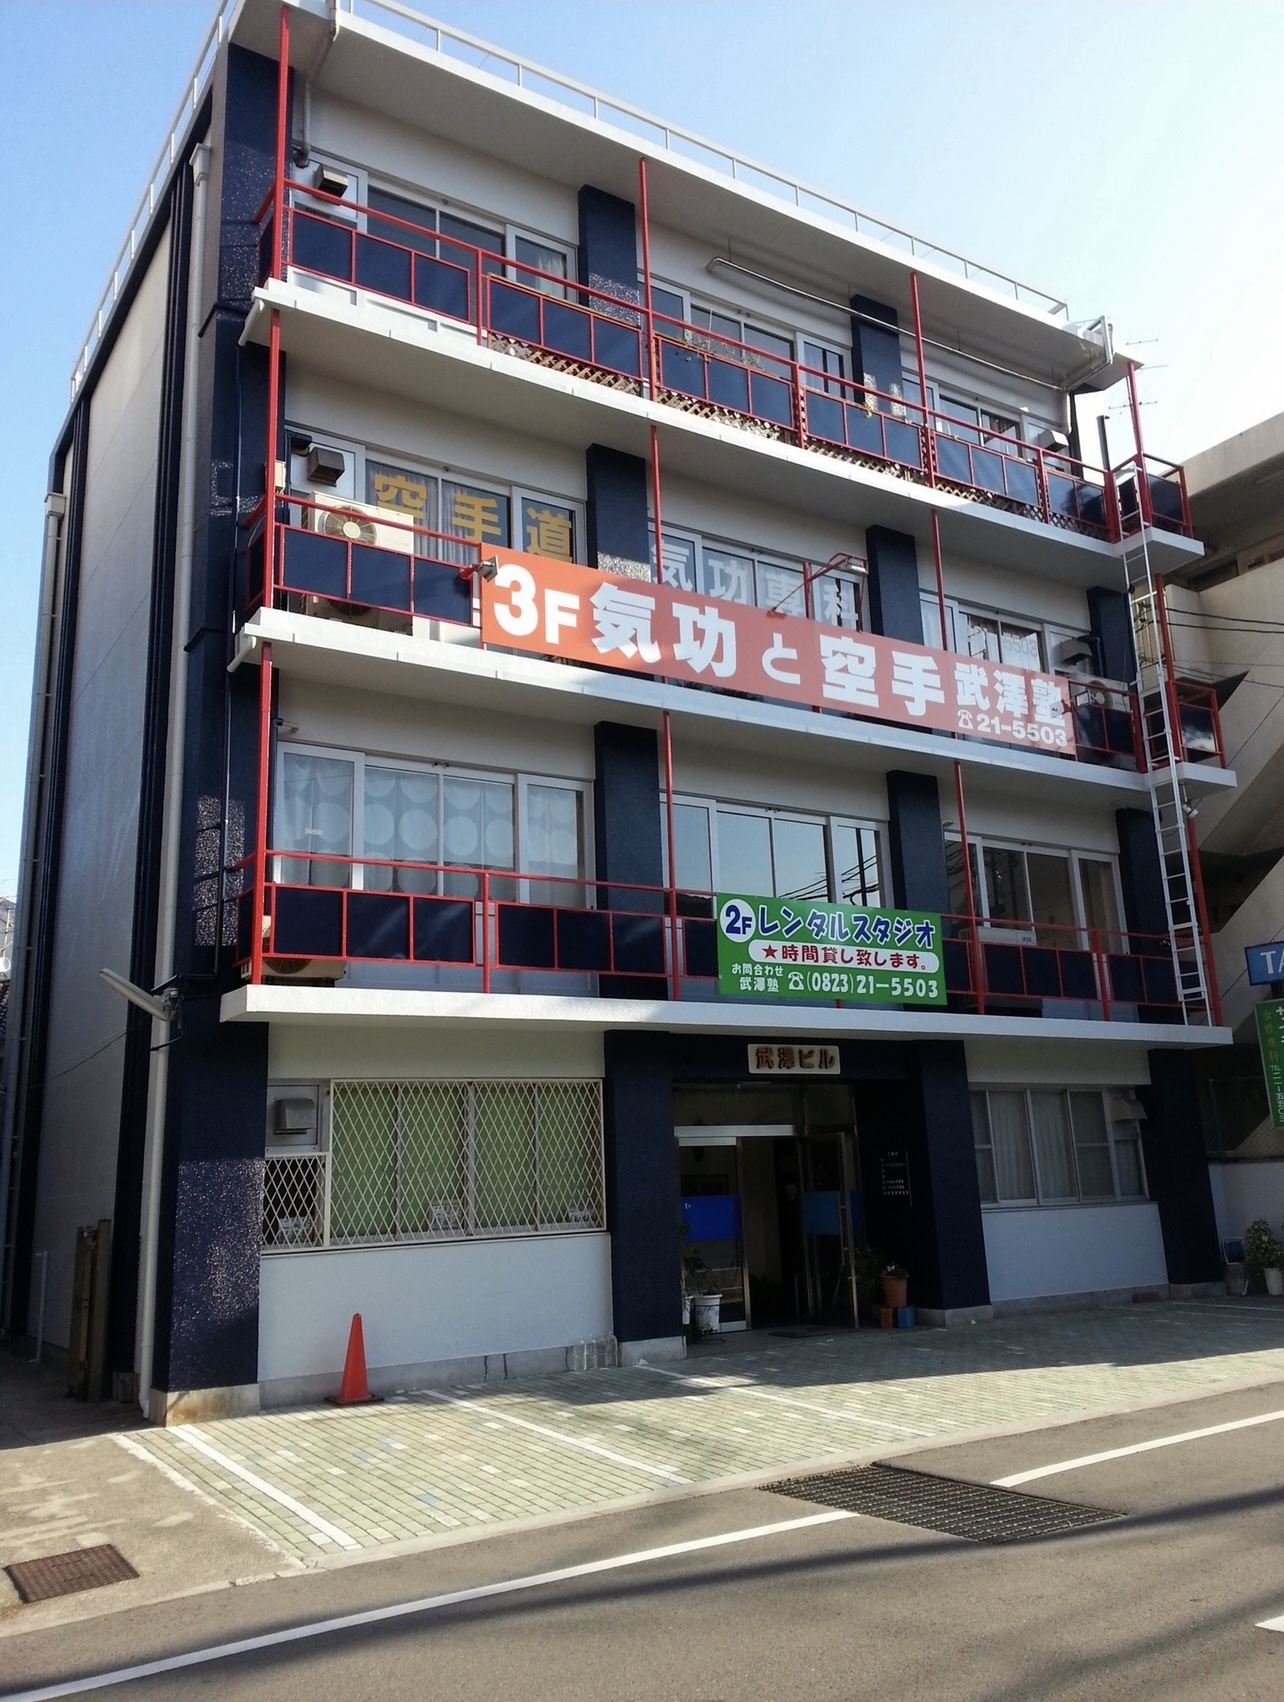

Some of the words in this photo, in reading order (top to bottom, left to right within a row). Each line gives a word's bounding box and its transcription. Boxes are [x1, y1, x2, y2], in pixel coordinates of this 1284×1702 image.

[373, 473, 573, 563] 空手道
[493, 564, 580, 645] 3F
[976, 713, 1068, 747] 21-5503
[725, 904, 753, 935] 2F
[759, 904, 936, 948] レンタルスタジオ
[731, 962, 784, 977] お問合わせ
[781, 944, 927, 971] 時間貸し致します。
[755, 1046, 835, 1070] 武澤ビル
